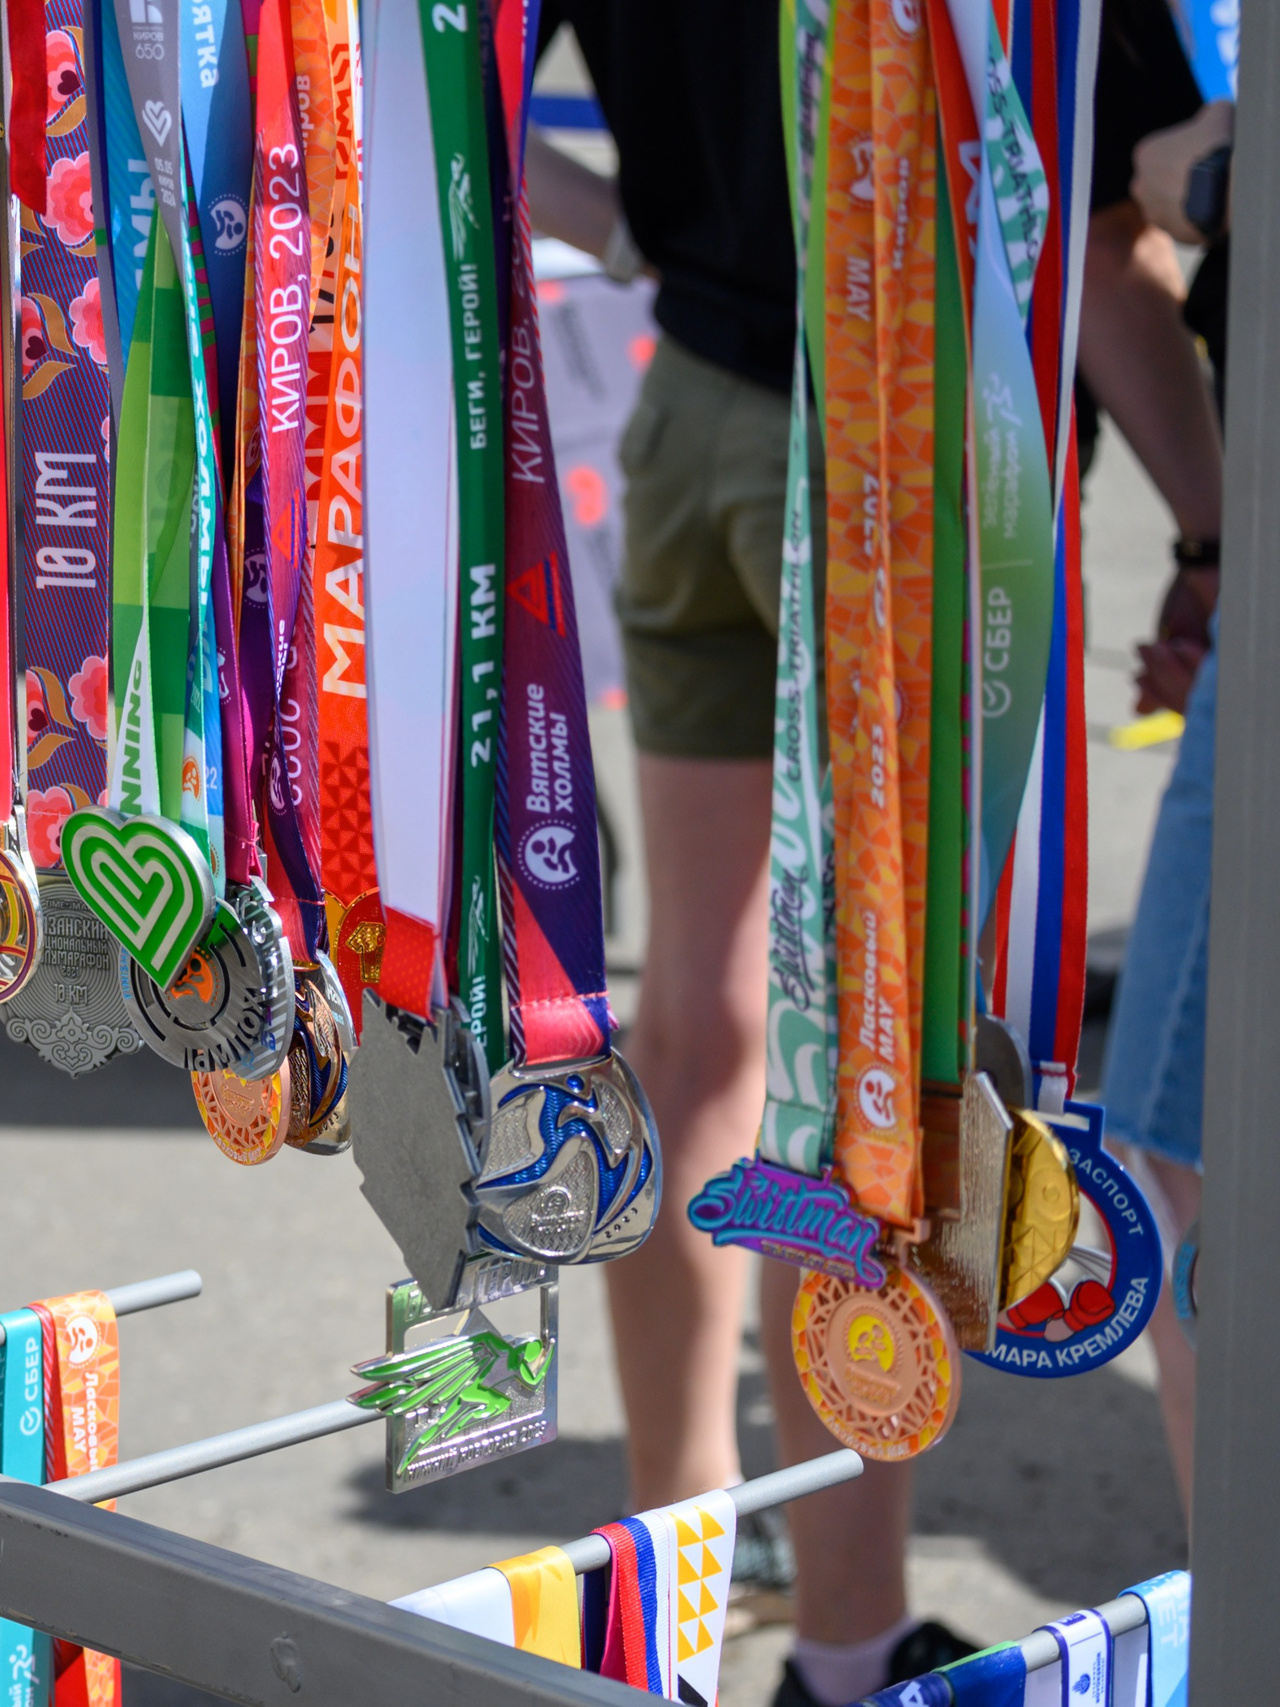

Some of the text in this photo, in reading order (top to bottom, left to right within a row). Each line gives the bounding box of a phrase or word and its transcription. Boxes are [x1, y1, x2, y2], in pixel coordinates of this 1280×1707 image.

[135, 44, 165, 60] 650
[191, 0, 220, 88] ятка
[268, 143, 303, 260] 2023
[845, 256, 872, 323] MAY
[459, 263, 489, 451] БЕГИ, ГЕРОЙ!
[34, 450, 98, 590] 10 КМ
[469, 563, 498, 768] 21,1 КМ
[984, 586, 1013, 673] СБЕР
[525, 682, 551, 815] Вятские
[549, 712, 574, 813] холмы
[870, 723, 885, 807] 2023
[470, 975, 488, 1048] ЕРОЙ!
[857, 910, 879, 1050] Ласковый
[878, 997, 898, 1063] MAY
[1055, 1276, 1150, 1369] КРЕМЛЕВА
[25, 1337, 40, 1402] СБЕР
[71, 1406, 87, 1454] MAY
